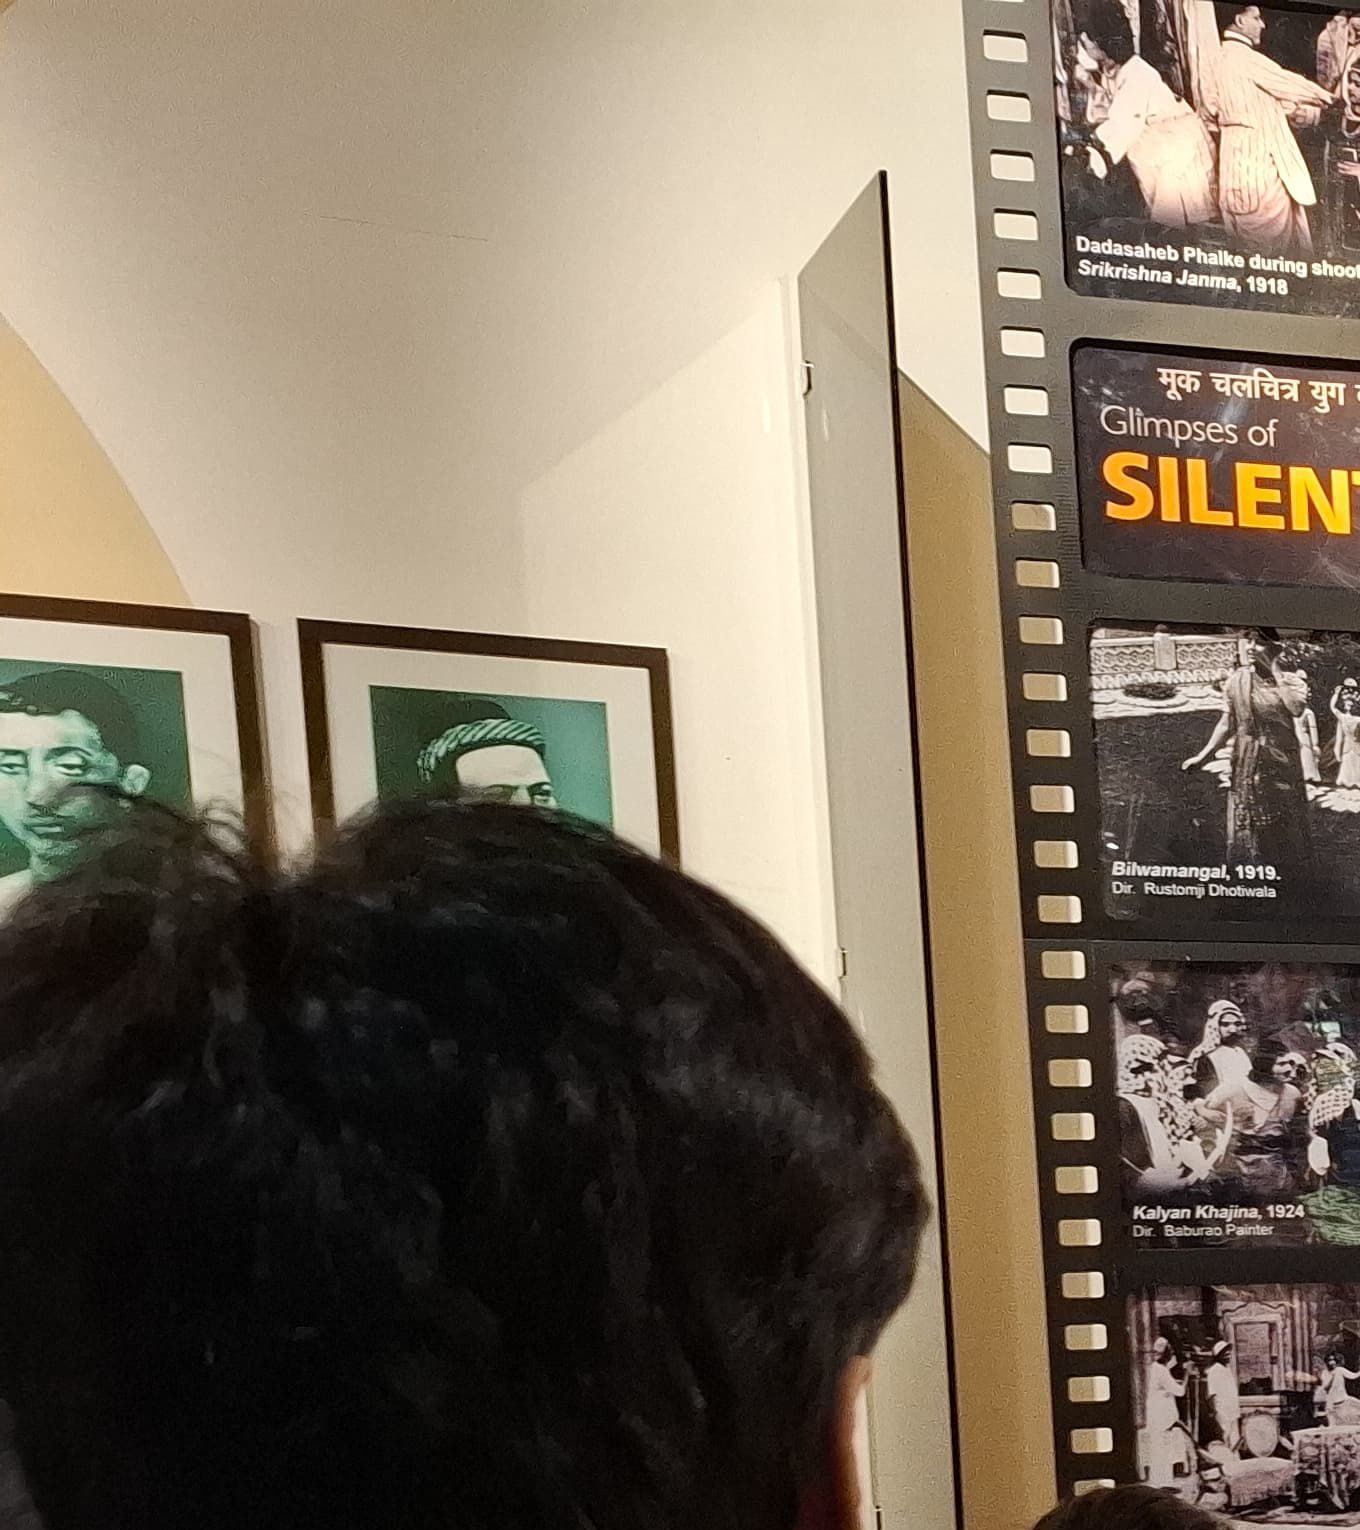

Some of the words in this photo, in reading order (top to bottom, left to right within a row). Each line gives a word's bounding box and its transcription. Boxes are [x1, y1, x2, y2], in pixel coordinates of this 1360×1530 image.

[1075, 236, 1178, 262] Dadasaheb
[1184, 247, 1245, 268] Phalke
[1249, 253, 1307, 277] during
[1078, 260, 1172, 283] Srikrishna
[1176, 270, 1241, 292] Janma,
[1246, 276, 1289, 295] 1918
[1157, 367, 1202, 401] मूक
[1209, 368, 1300, 402] चलचित्र
[1309, 380, 1347, 414] युग
[1101, 405, 1238, 448] Glimpses
[1248, 419, 1280, 447] of
[1112, 861, 1231, 882] Bilwamangal,
[1235, 864, 1282, 881] 1919.
[1112, 881, 1136, 895] Dir.
[1144, 882, 1205, 899] Rustomji
[1208, 883, 1277, 898] Dhotiwala
[1132, 1205, 1191, 1223] Kalyan
[1195, 1204, 1263, 1222] Khajina,
[1266, 1204, 1306, 1218] 1924
[1132, 1225, 1157, 1237] Dir.
[1164, 1224, 1223, 1237] Baburao
[1225, 1223, 1274, 1236] Painter
